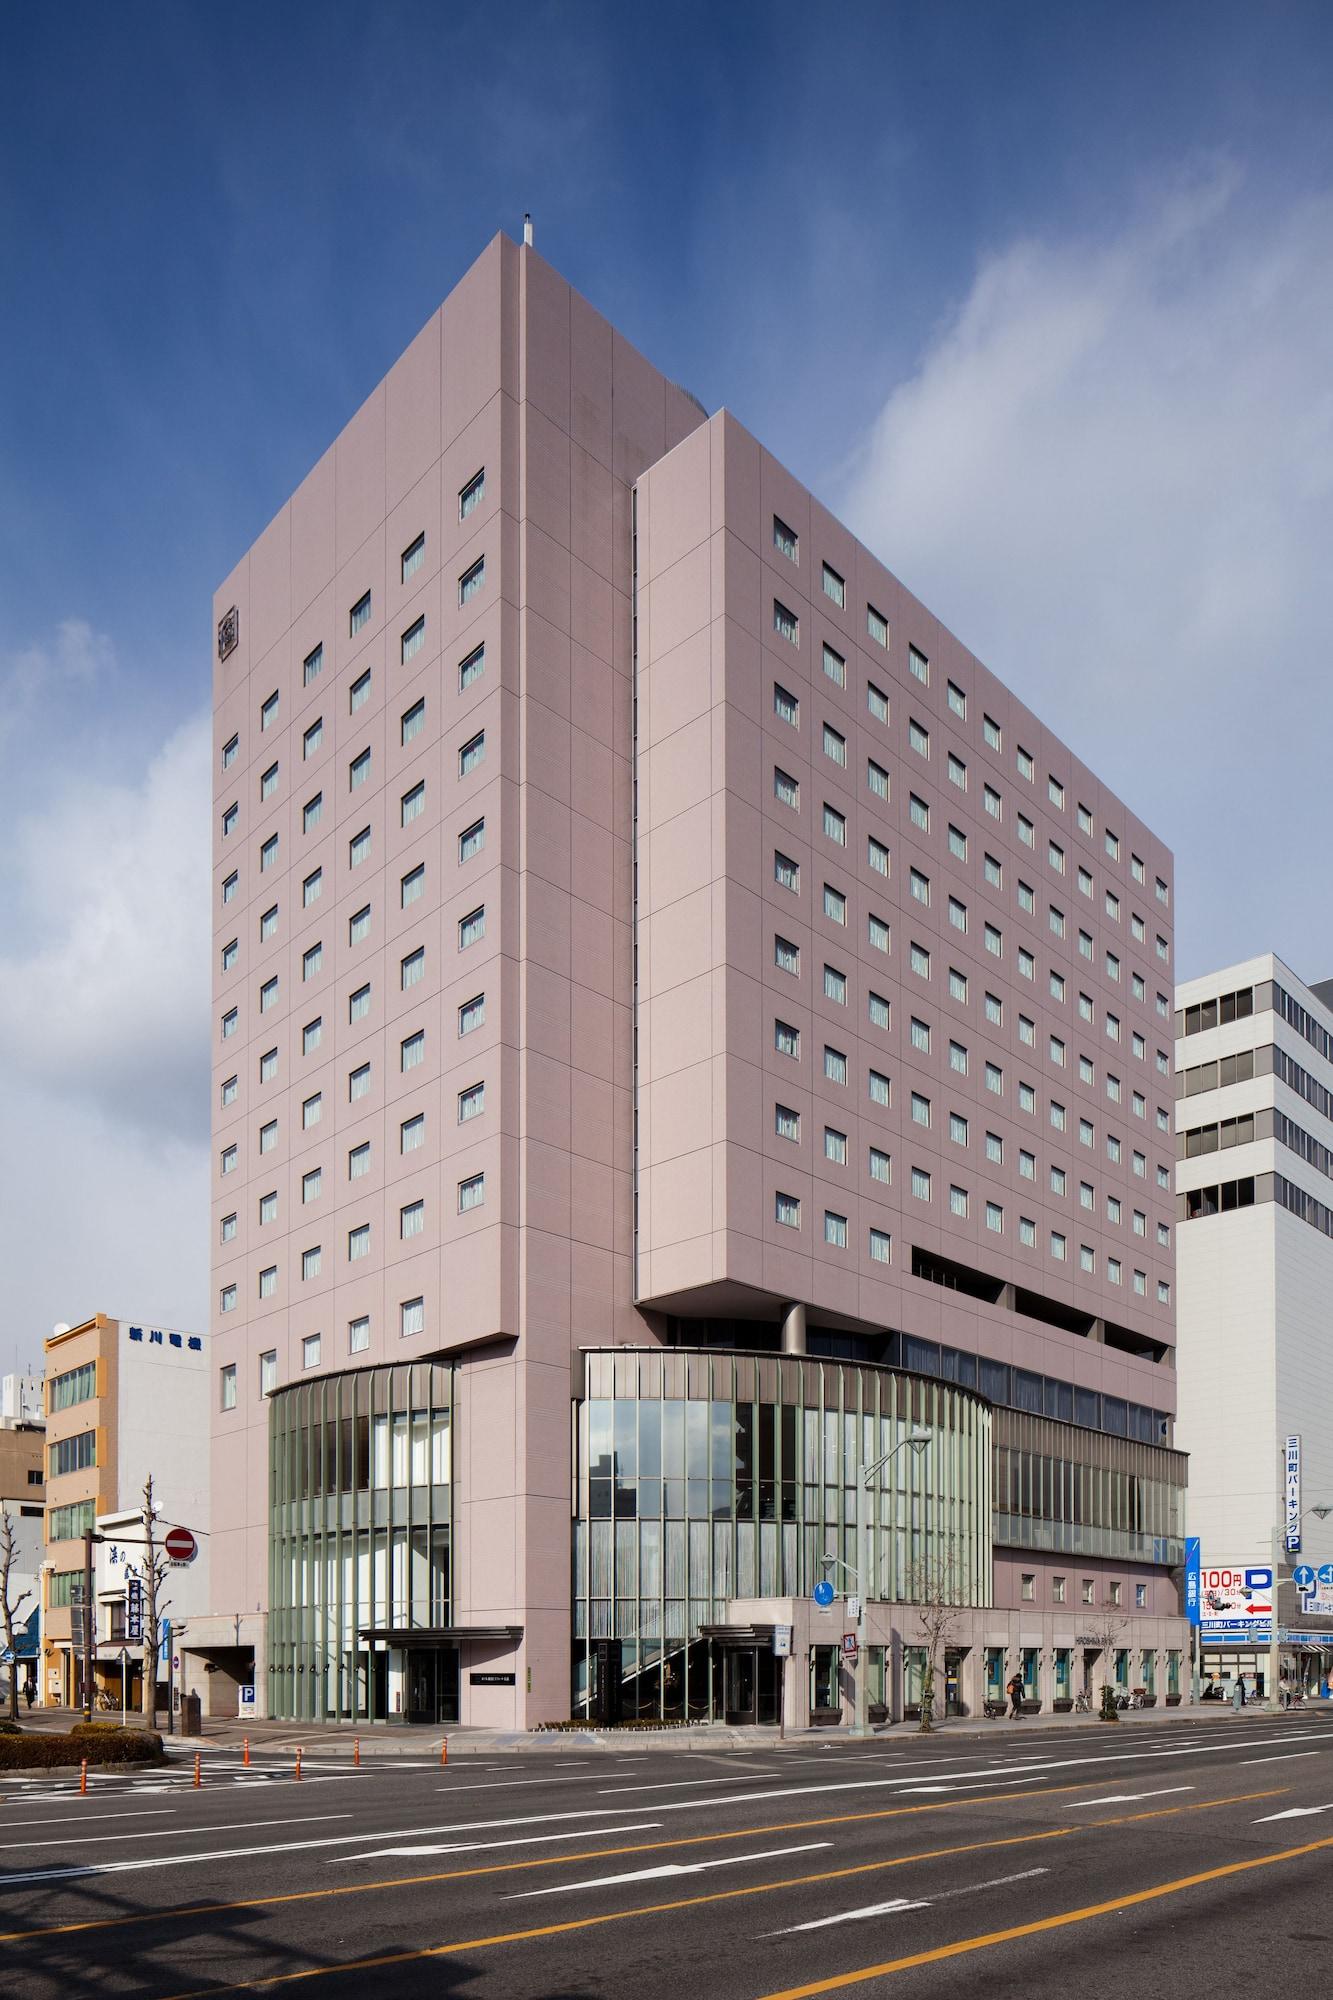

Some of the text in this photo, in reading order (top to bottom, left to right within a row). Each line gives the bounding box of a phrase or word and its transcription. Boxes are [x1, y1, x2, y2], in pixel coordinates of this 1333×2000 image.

[1288, 1438, 1298, 1533] 三川町パーキング
[1288, 1537, 1299, 1549] P
[1187, 1572, 1197, 1606] 広島銀行
[1201, 1570, 1242, 1588] 100円
[1245, 1569, 1273, 1600] P
[245, 1688, 254, 1701] P
